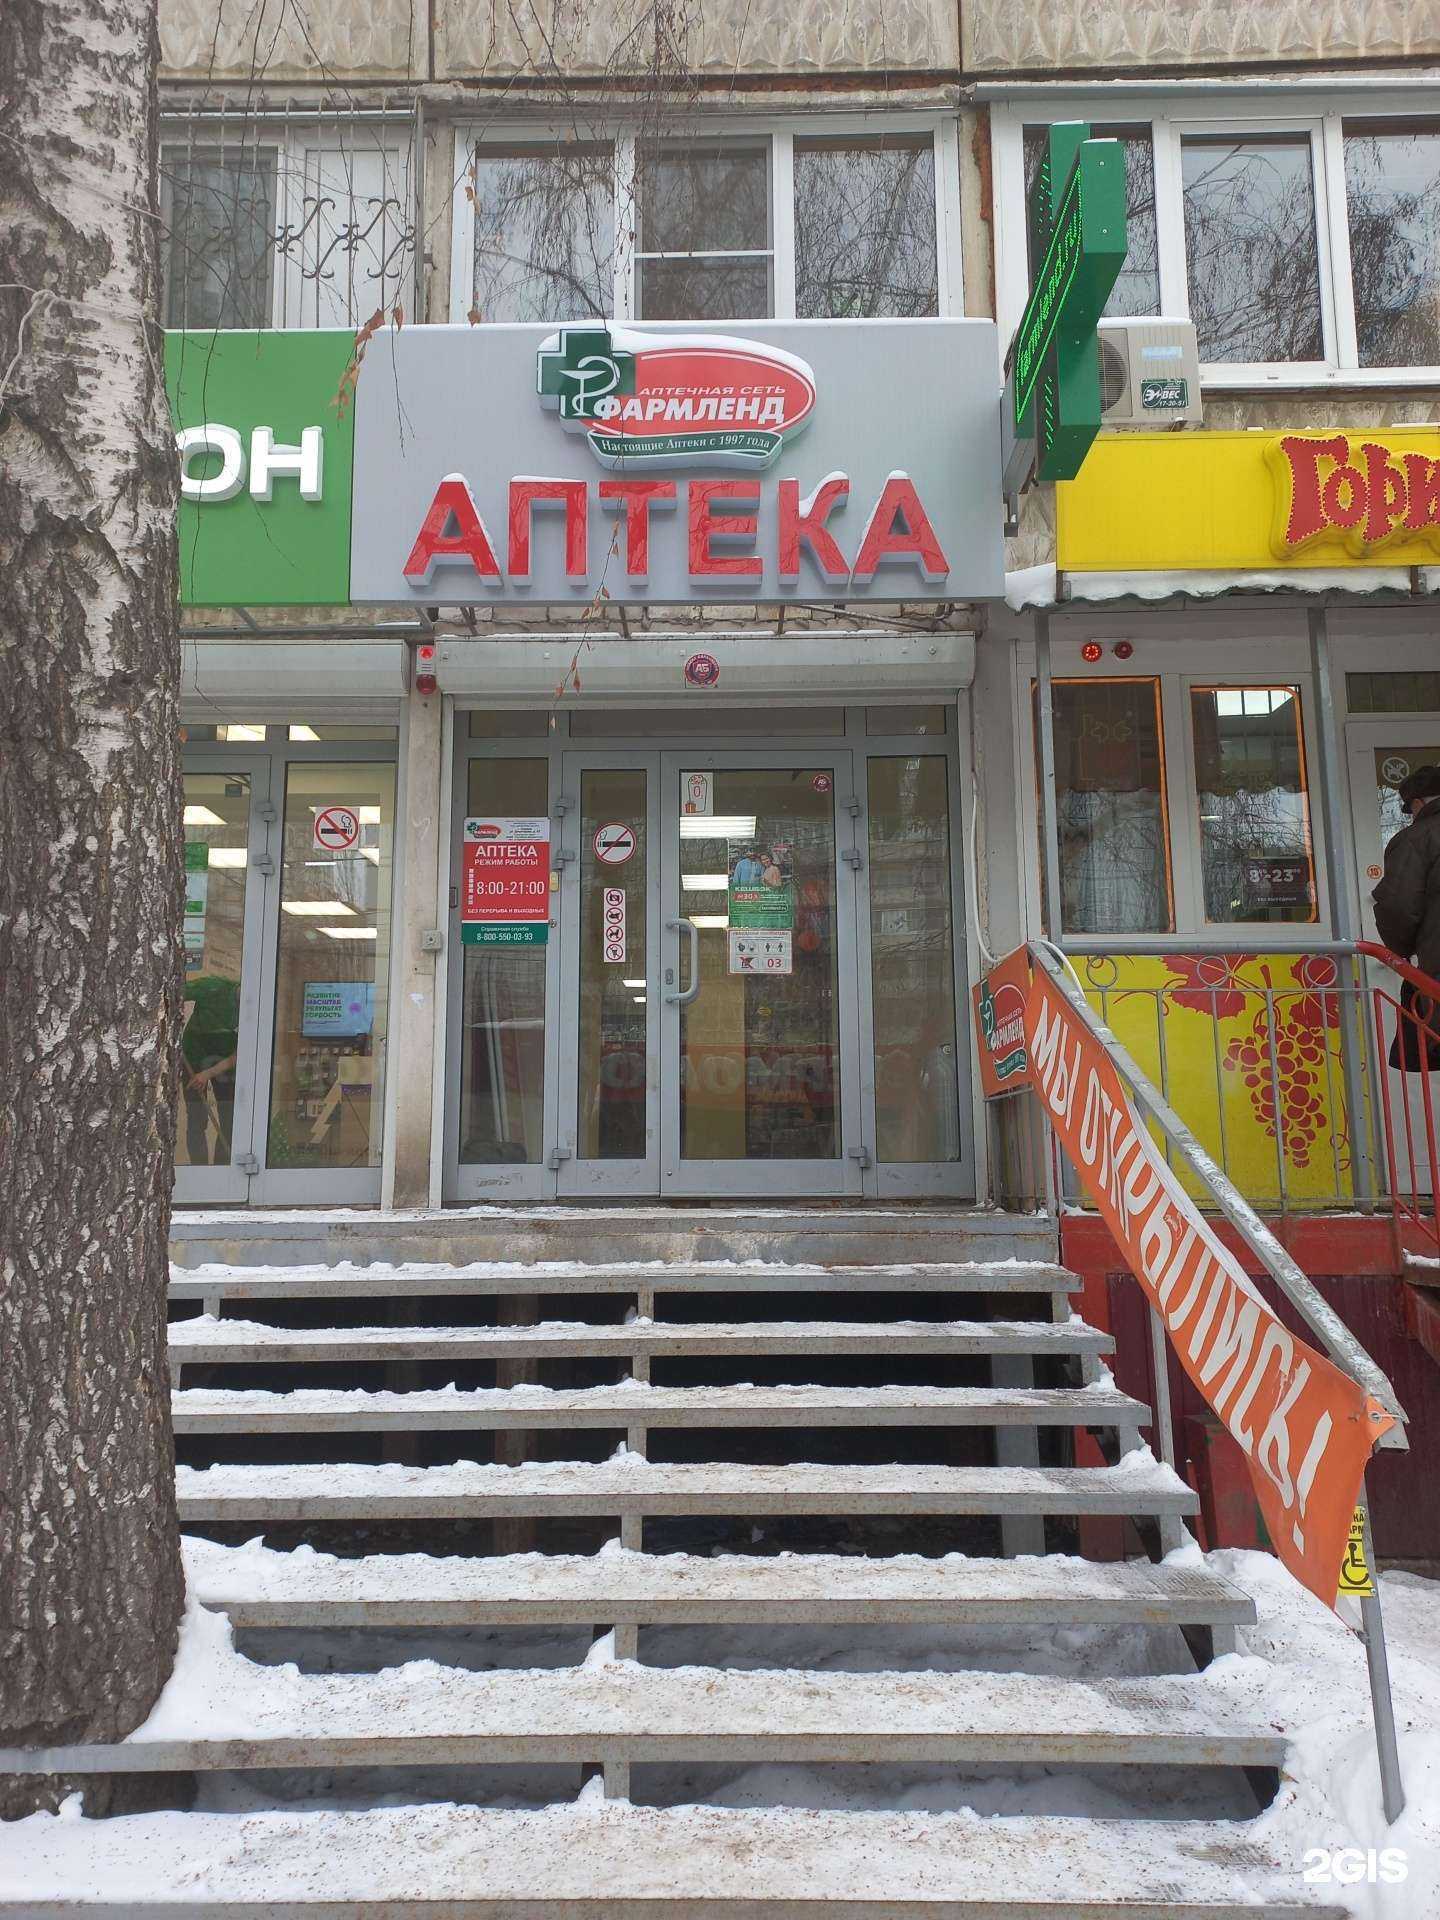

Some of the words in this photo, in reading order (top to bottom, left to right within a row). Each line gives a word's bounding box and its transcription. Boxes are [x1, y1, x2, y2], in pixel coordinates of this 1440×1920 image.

[639, 387, 734, 395] АПТЕЧНАЯ
[740, 386, 786, 394] СЕТЬ
[593, 395, 785, 425] ФАРМЛЕНД
[602, 439, 664, 452] Настоящие
[666, 437, 707, 449] Аптеки
[719, 434, 745, 446] 1997
[747, 436, 770, 449] года
[403, 475, 950, 580] АПТЕКА
[475, 844, 538, 857] АПТЕКА
[474, 858, 503, 866] РЕЖИМ
[505, 858, 538, 866] РАБОТЫ
[476, 881, 545, 895] 8:00-21:00
[767, 958, 783, 968] 03
[1031, 995, 1082, 1131] МЫ
[1080, 1067, 1333, 1557] ОТКРЫЛИСЬ!
